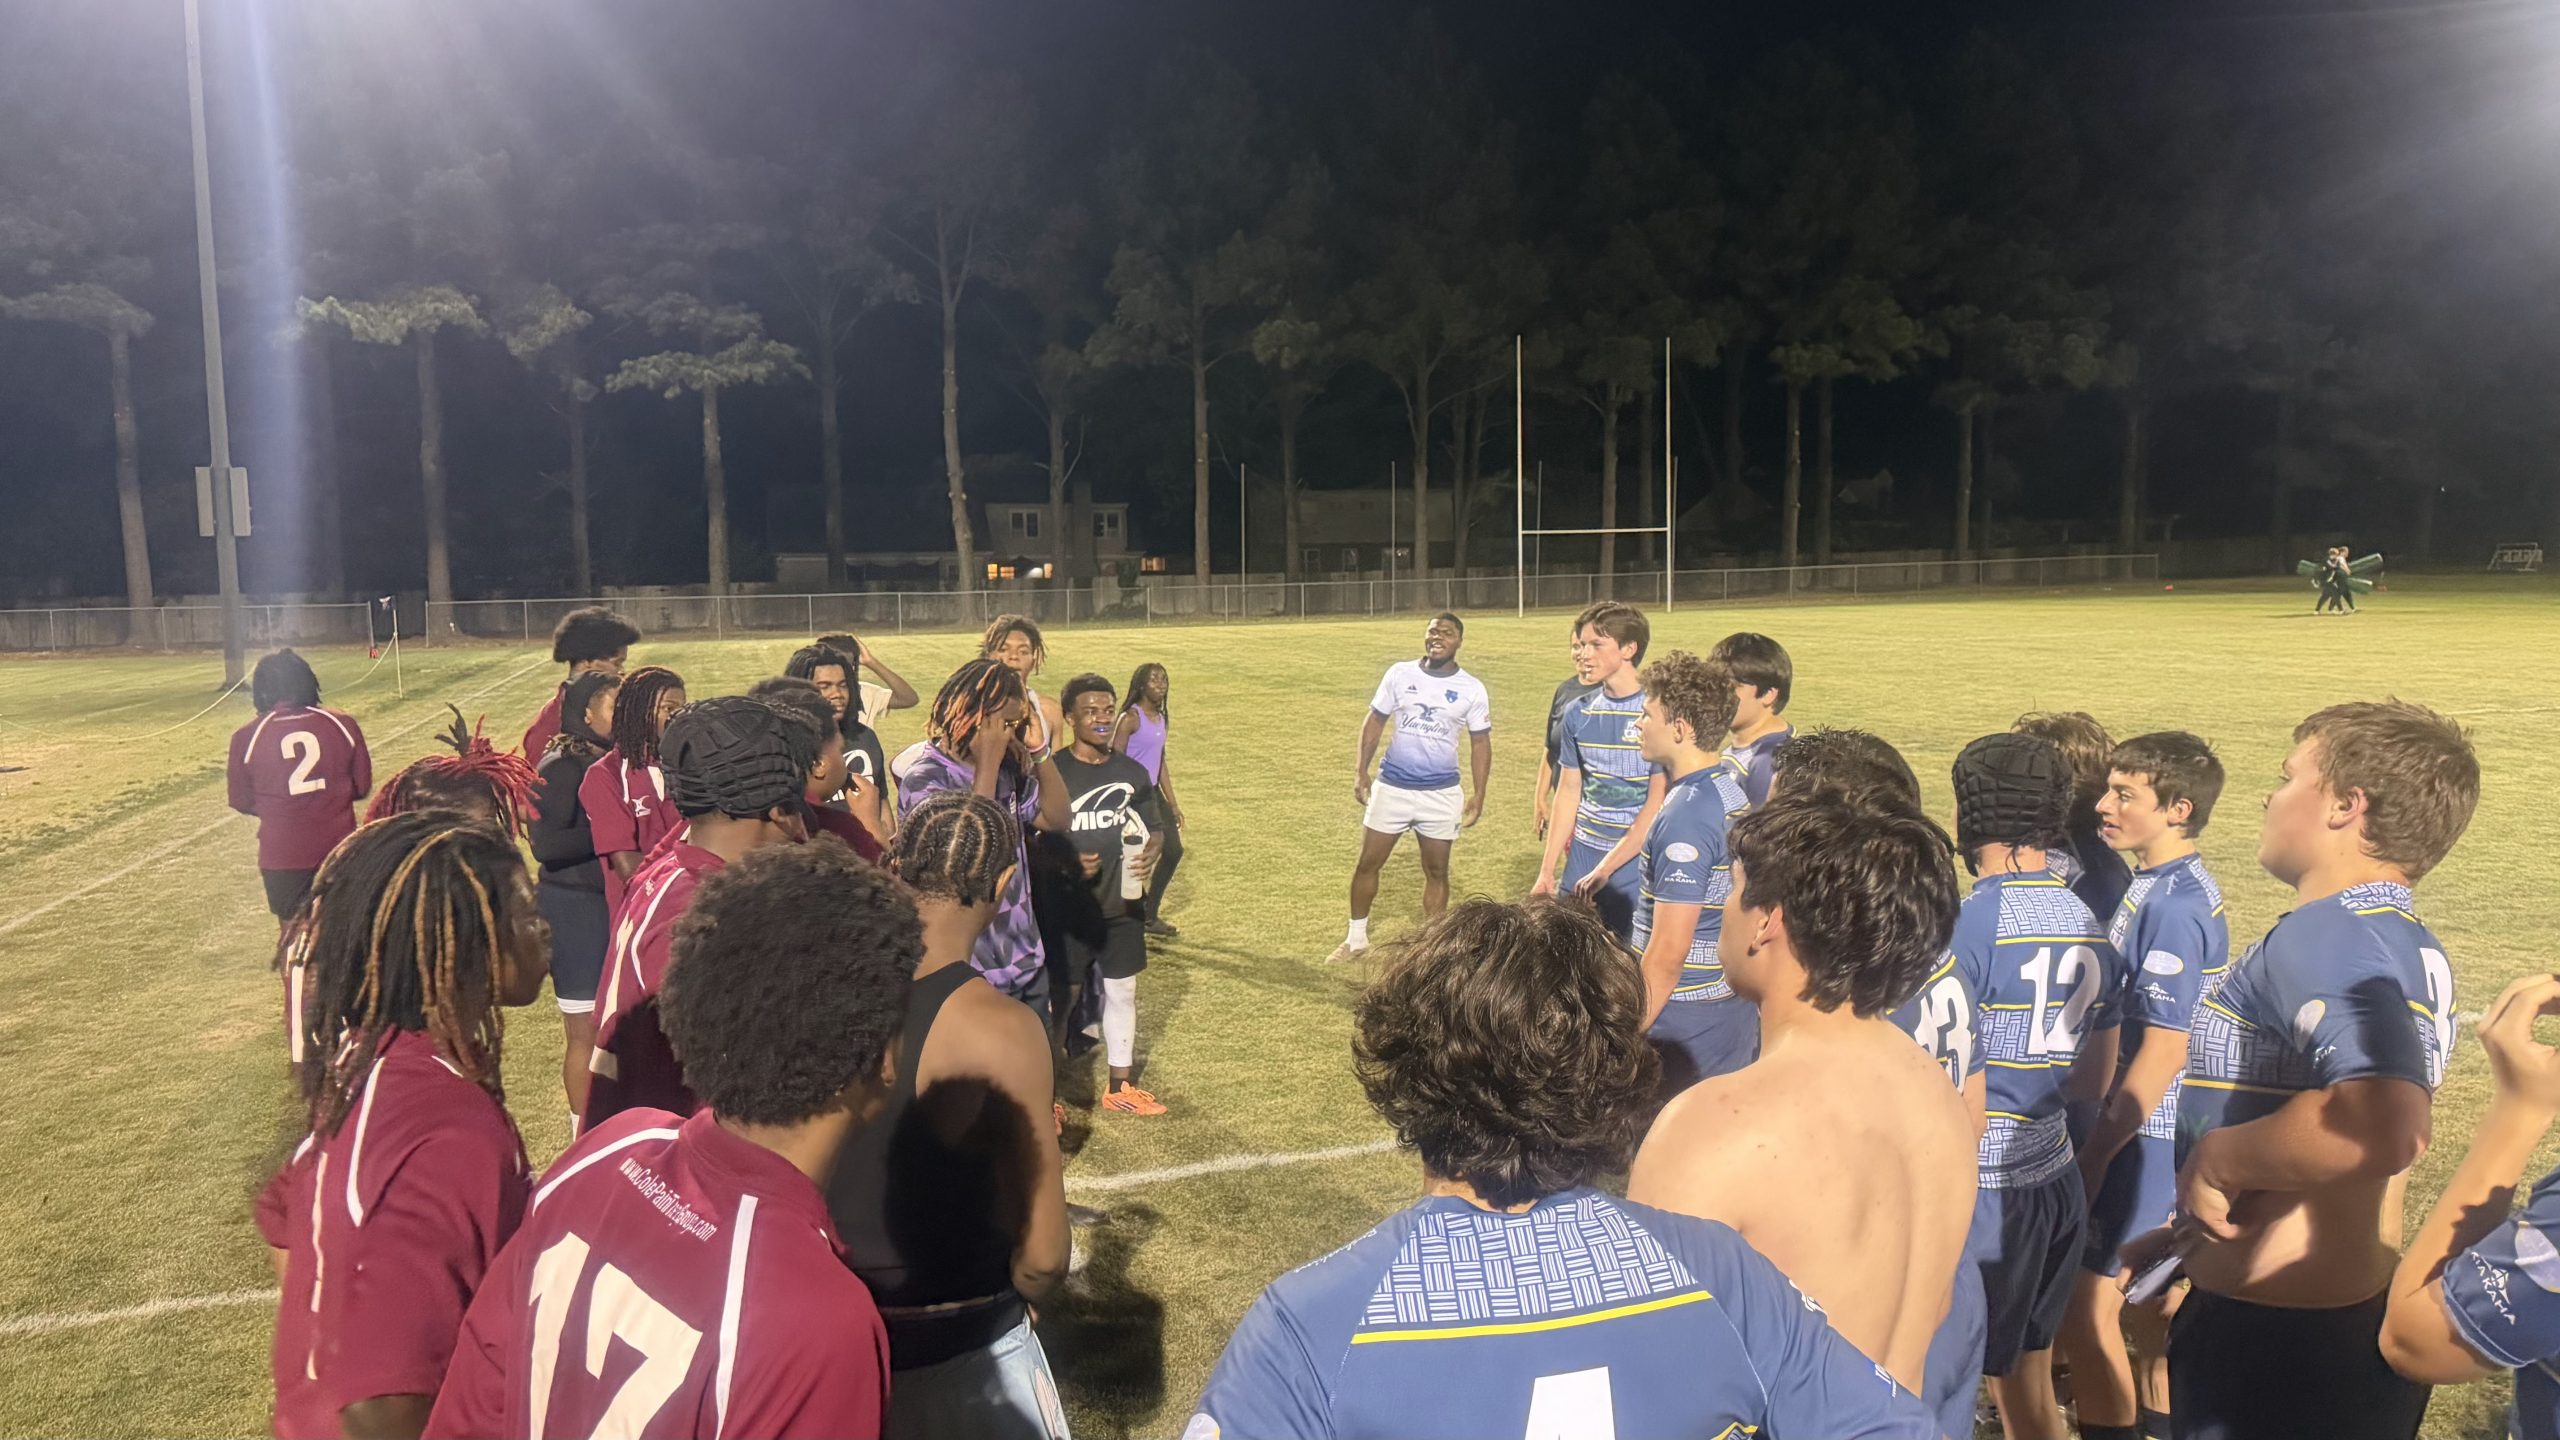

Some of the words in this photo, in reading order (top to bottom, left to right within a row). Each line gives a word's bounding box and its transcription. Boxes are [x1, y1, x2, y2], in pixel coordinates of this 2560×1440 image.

[281, 731, 326, 795] 2
[2020, 945, 2101, 1055] 12
[528, 1232, 704, 1440] 17
[2482, 1277, 2517, 1326] KAHA
